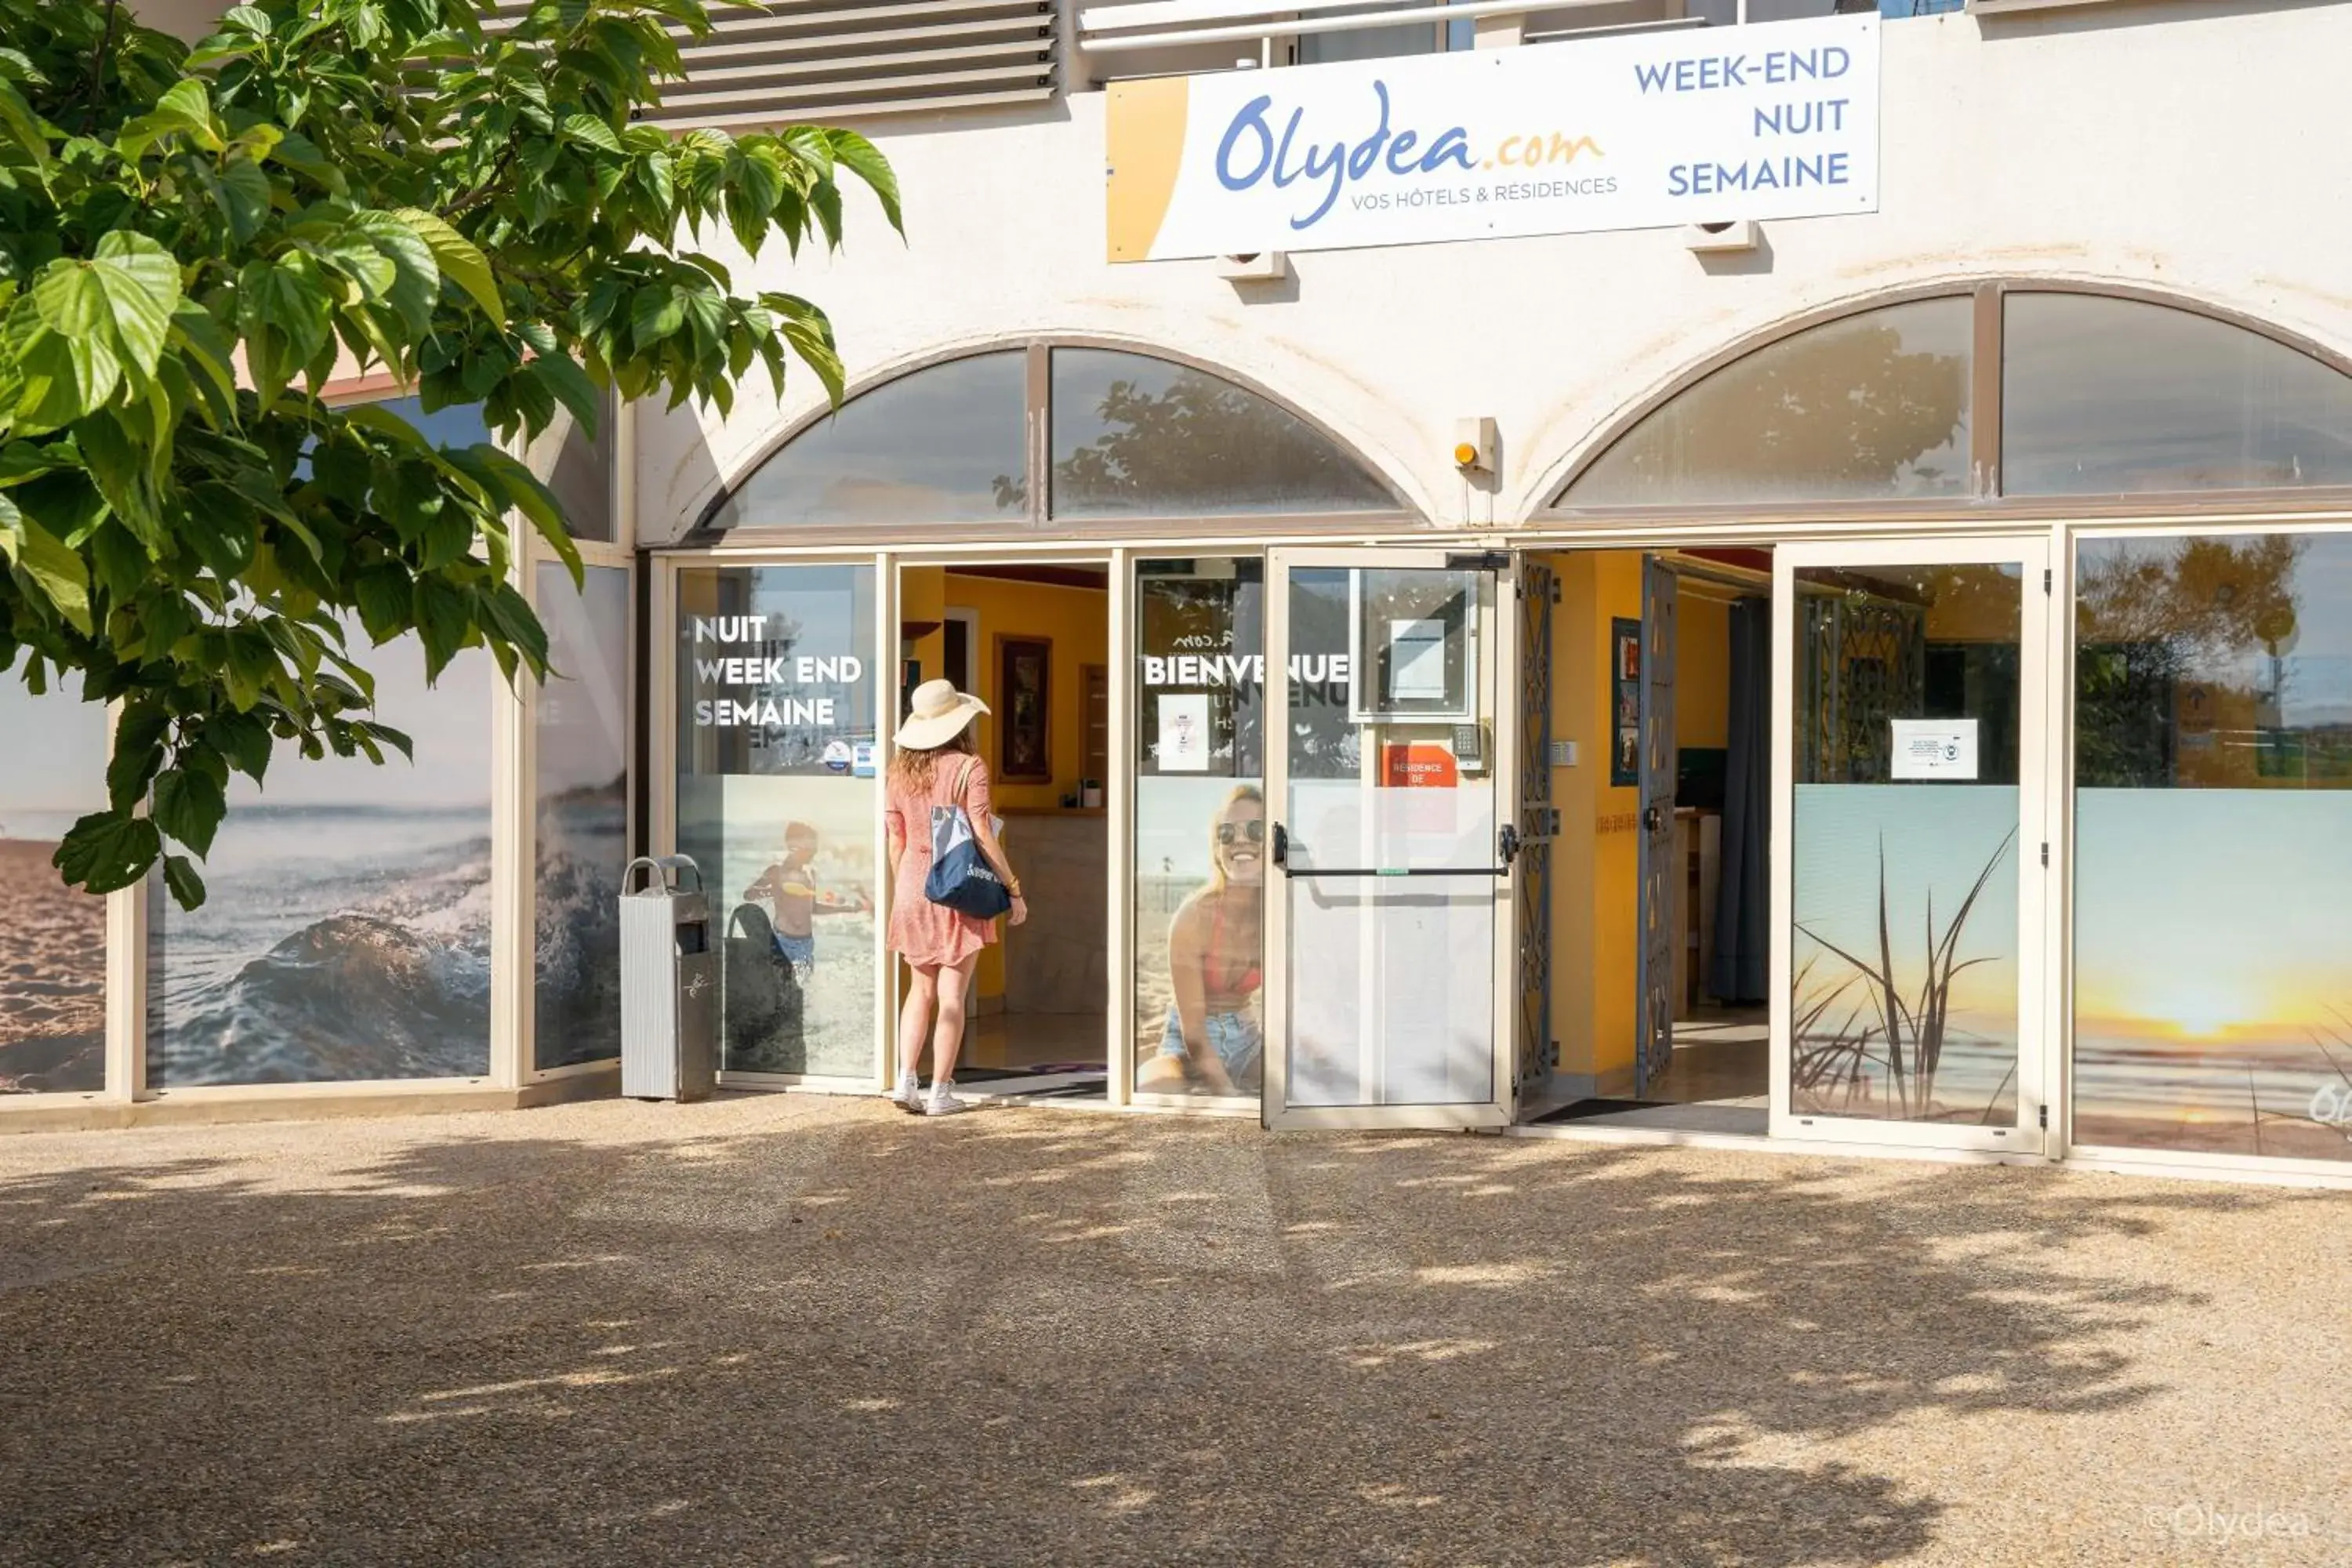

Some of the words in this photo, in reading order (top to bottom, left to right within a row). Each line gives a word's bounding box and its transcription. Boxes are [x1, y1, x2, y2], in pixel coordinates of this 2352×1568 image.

[1635, 46, 1850, 95] WEEK-END
[1753, 99, 1849, 137] NUIT
[1216, 79, 1606, 230] Olydea.com
[1668, 153, 1849, 196] SEMAINE
[1351, 194, 1390, 211] VOS
[1396, 187, 1471, 208] HÔTELS
[1475, 187, 1490, 202] &
[695, 615, 768, 643] NUIT
[695, 657, 785, 684] WEEK
[796, 656, 862, 684] END
[695, 699, 835, 726] SEMAINE
